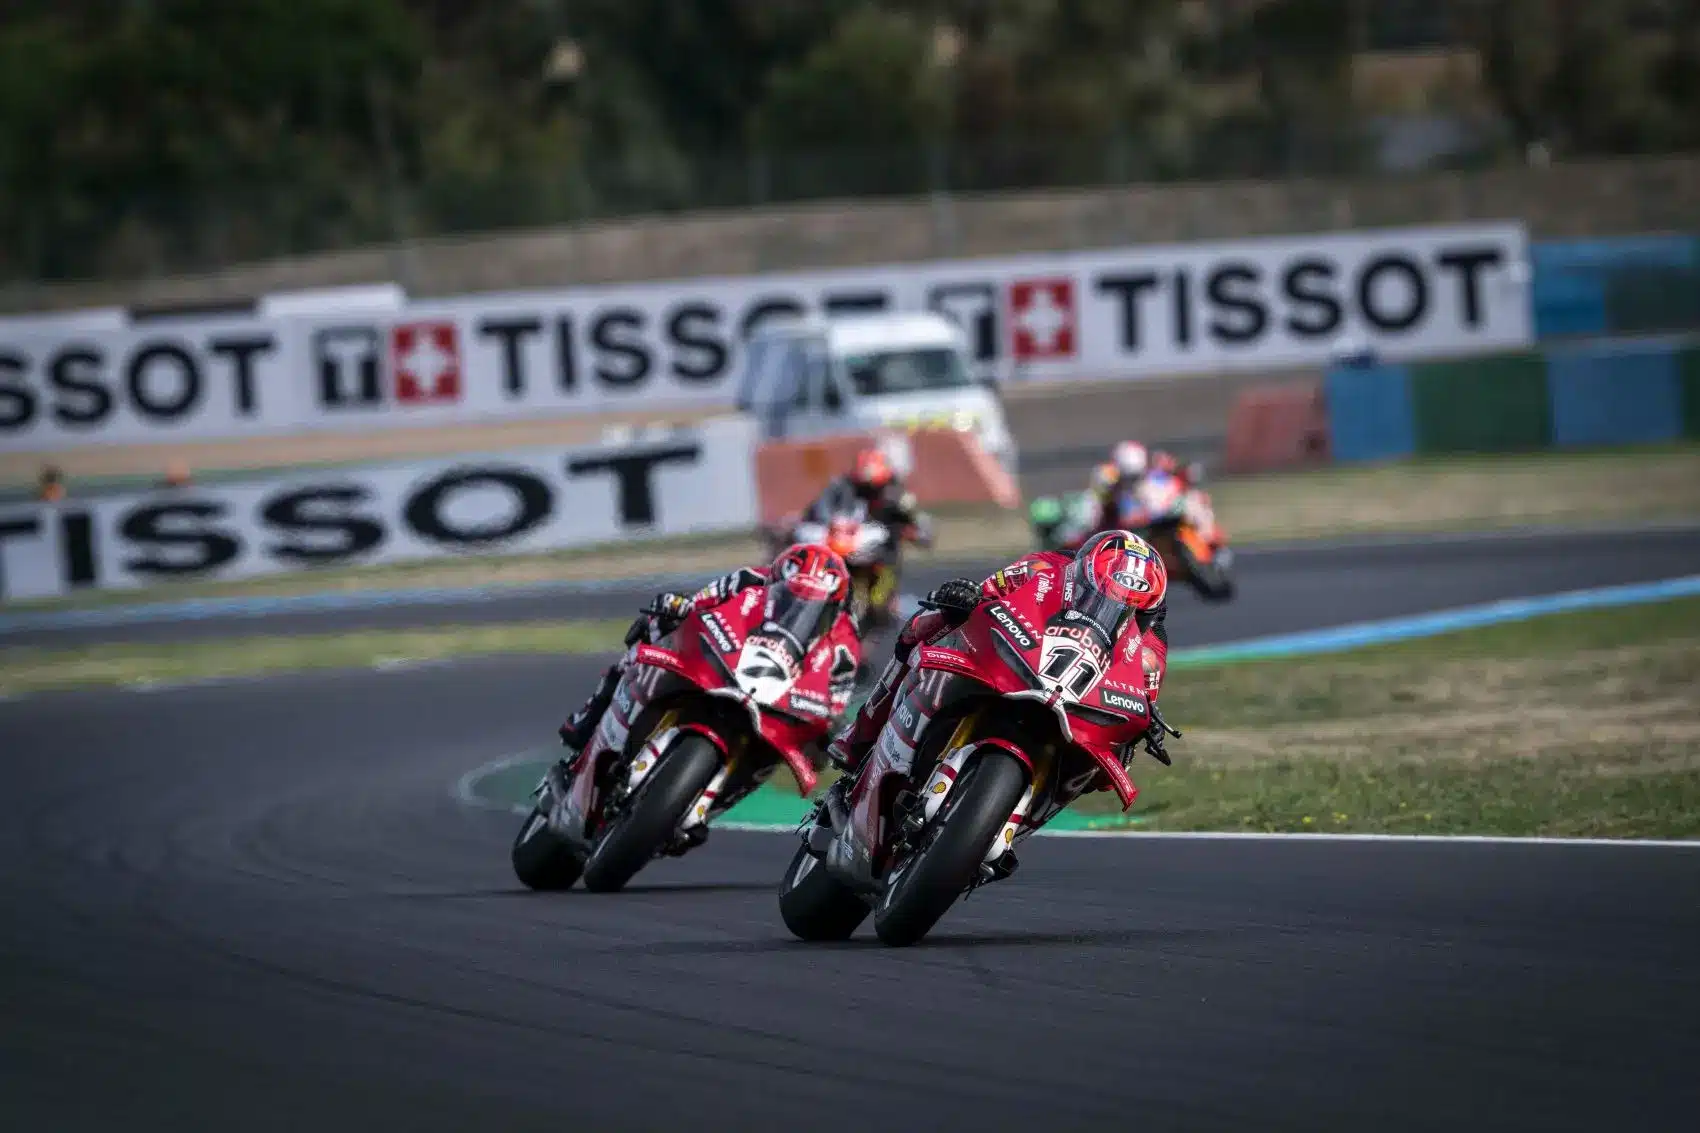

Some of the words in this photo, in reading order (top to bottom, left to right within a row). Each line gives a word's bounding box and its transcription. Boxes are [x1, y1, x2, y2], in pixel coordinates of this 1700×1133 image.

[1096, 248, 1503, 352] TISSOT
[990, 606, 1030, 646] Lenovo
[1045, 626, 1111, 674] aruba.it
[1040, 646, 1100, 700] 11
[1104, 679, 1145, 696] ALTEN
[1103, 691, 1144, 713] Lenovo
